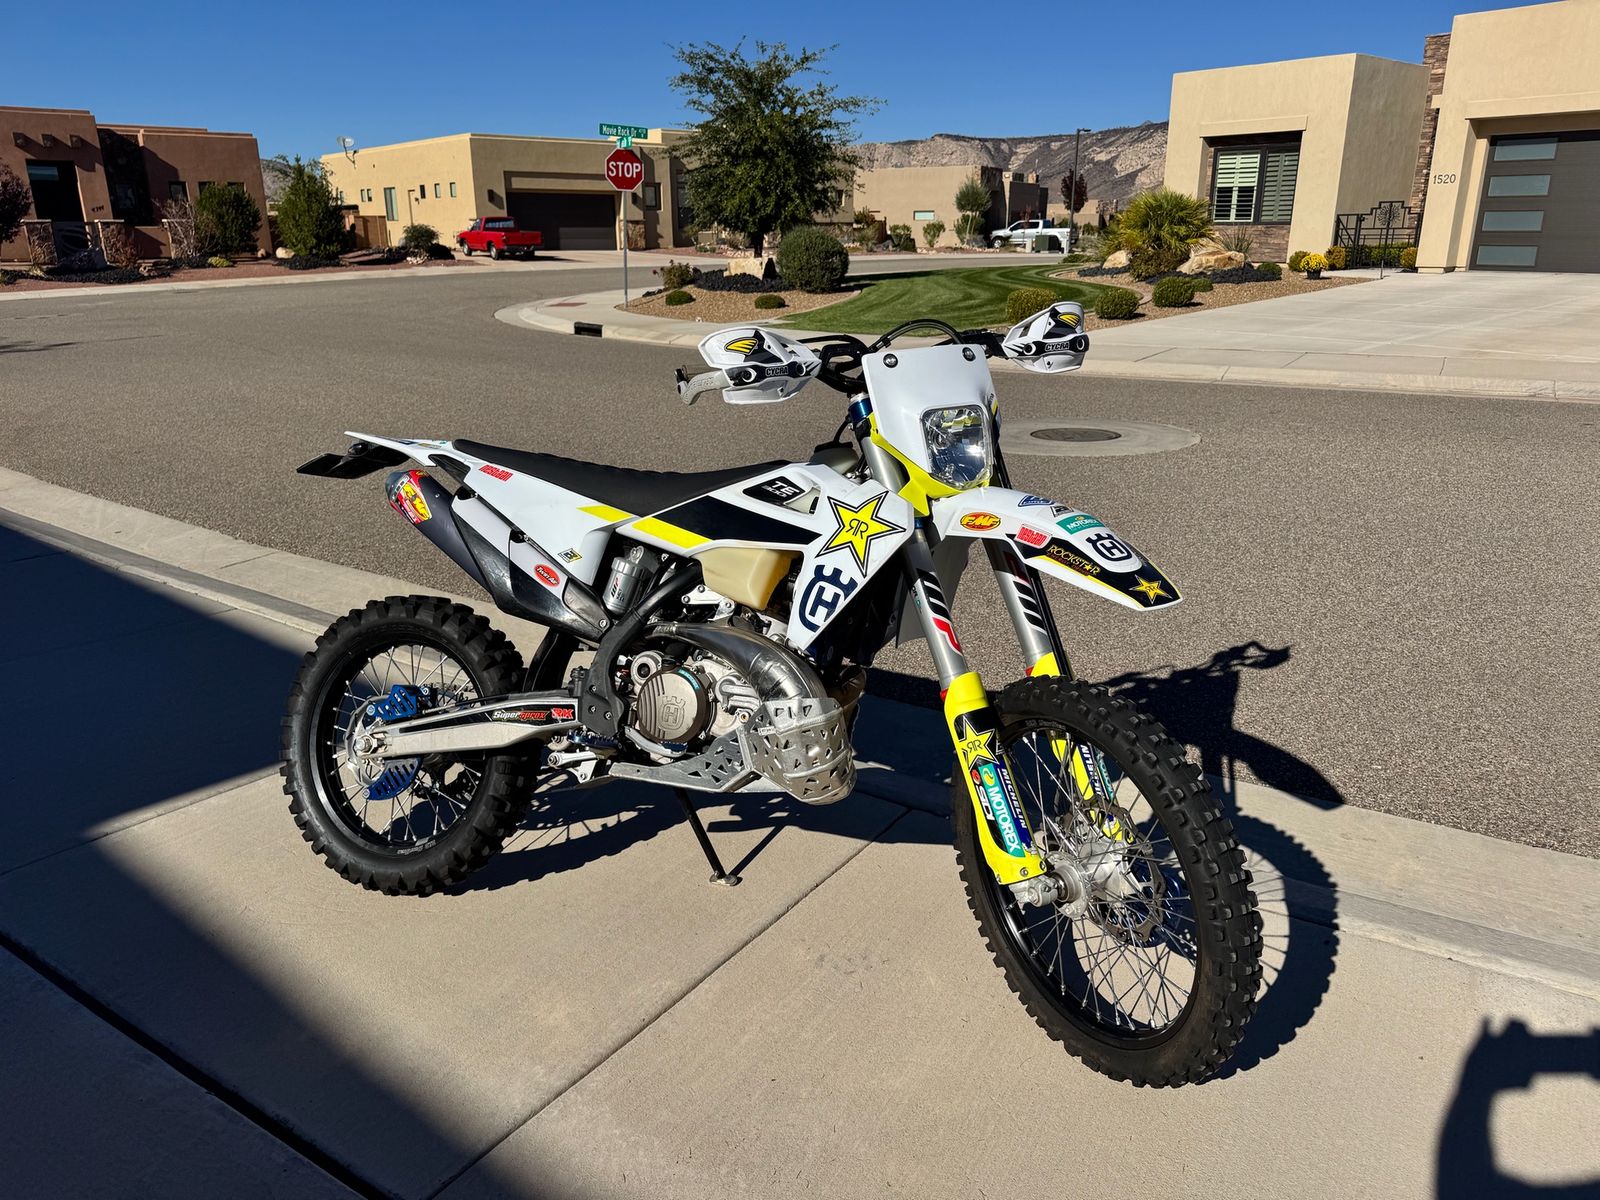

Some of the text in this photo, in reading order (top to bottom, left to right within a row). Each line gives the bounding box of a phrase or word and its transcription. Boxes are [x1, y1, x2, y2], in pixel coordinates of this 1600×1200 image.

[602, 125, 617, 136] Movie
[617, 126, 630, 137] Rock
[631, 127, 638, 137] Dr
[608, 161, 641, 178] STOP
[1433, 174, 1457, 184] 1520
[772, 481, 800, 496] TE
[960, 514, 1000, 526] FMF
[551, 707, 574, 719] RK
[1001, 768, 1028, 829] MICHELIN
[988, 786, 1021, 853] MOTOREX
